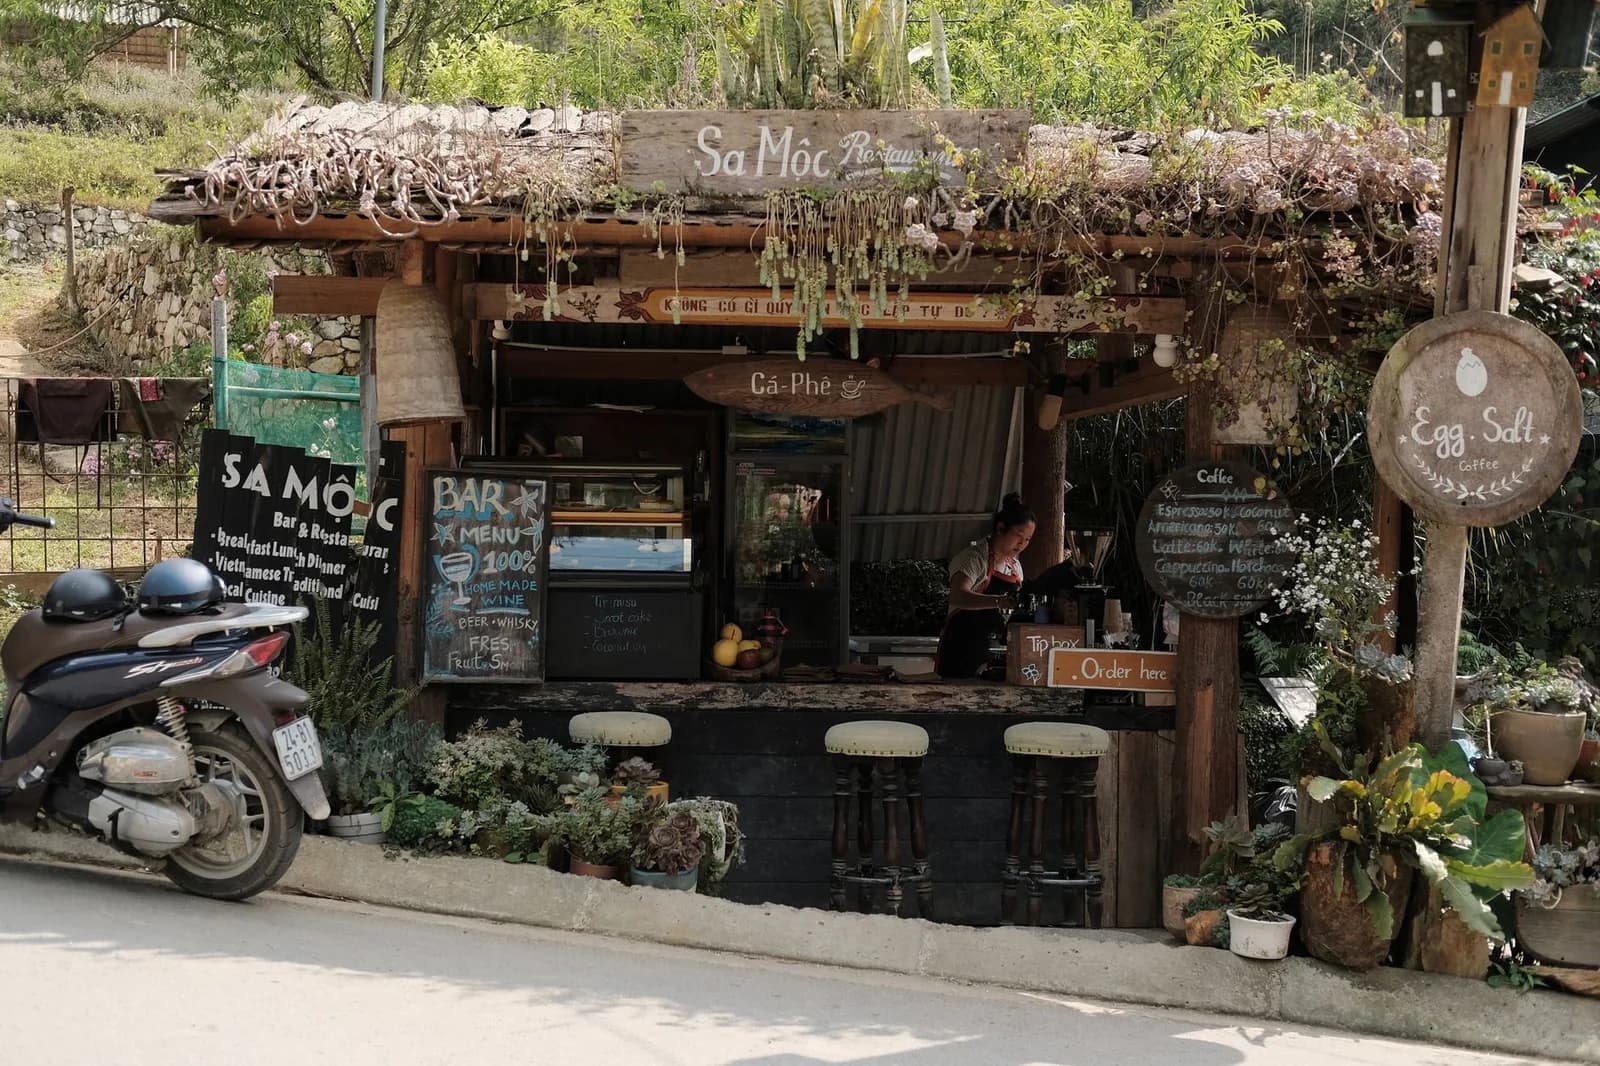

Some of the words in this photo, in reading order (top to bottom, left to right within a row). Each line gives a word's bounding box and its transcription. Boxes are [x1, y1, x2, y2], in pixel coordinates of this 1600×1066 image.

[697, 126, 746, 176] Sa
[756, 126, 831, 180] Mộc
[664, 297, 707, 312] KÔNG
[1411, 406, 1465, 459] Egg
[1483, 406, 1536, 443] Salt
[221, 452, 271, 497] SA
[1196, 467, 1234, 485] Coffee
[1459, 459, 1500, 472] Coffee
[433, 477, 512, 517] BAR
[273, 511, 297, 529] Bar
[298, 522, 309, 539] &
[460, 525, 520, 545] MENU
[215, 551, 282, 582] Vietnamese
[307, 552, 346, 575] Dinner
[483, 550, 536, 574] 100%
[465, 581, 496, 593] HOME
[499, 579, 538, 592] MADE
[481, 594, 525, 606] WINE
[458, 616, 489, 630] BEER
[497, 616, 538, 632] WHISKY
[1026, 635, 1049, 657] Tip
[1051, 635, 1080, 650] box
[1080, 656, 1132, 680] Order
[1140, 657, 1168, 681] here
